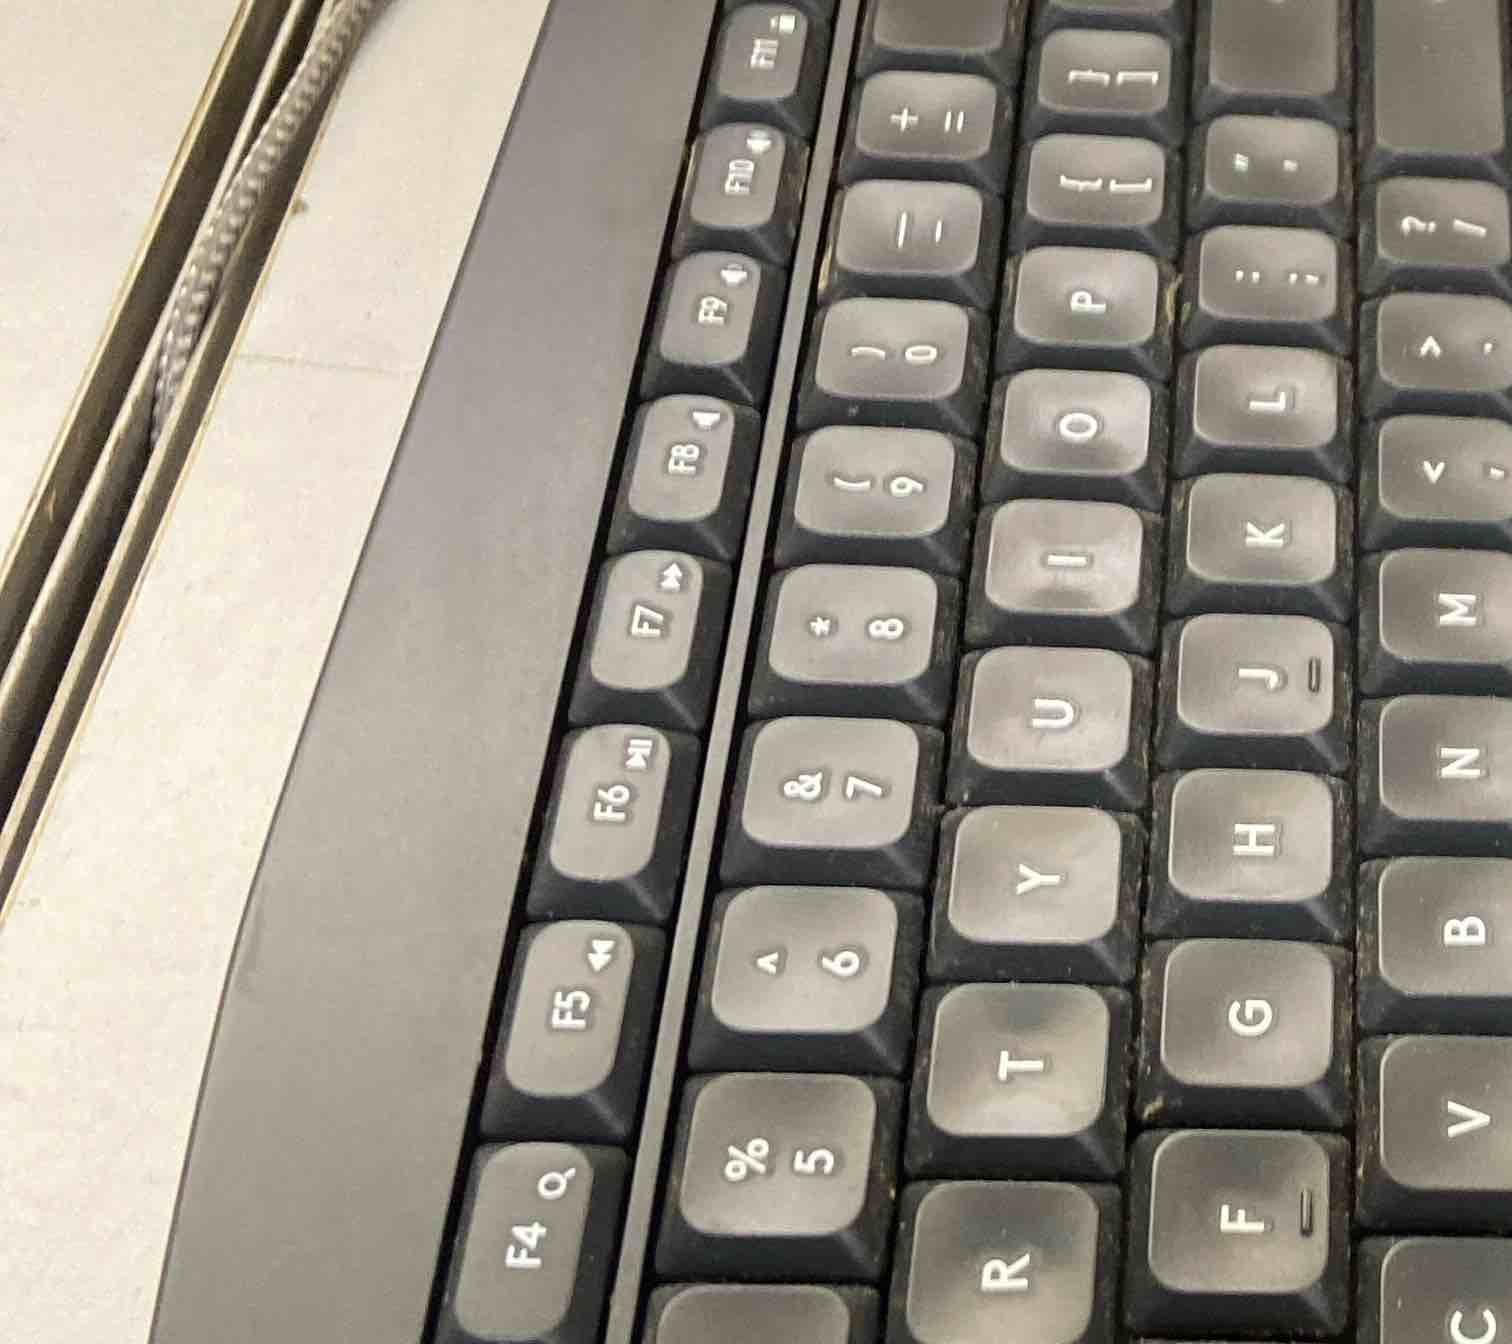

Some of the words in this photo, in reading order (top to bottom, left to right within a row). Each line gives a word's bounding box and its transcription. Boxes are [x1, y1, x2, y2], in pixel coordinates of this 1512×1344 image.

[1401, 215, 1437, 233] ?
[1453, 219, 1487, 237] /
[698, 296, 728, 324] F9
[1070, 291, 1106, 312] P
[851, 346, 886, 358] )
[1249, 391, 1287, 412] L
[1059, 412, 1098, 441] O
[668, 444, 700, 473] F8
[834, 477, 871, 490] (
[890, 476, 923, 497] 9
[1245, 521, 1285, 547] K
[1047, 554, 1087, 565] I
[631, 605, 664, 636] F7
[1438, 593, 1477, 626] M
[869, 618, 904, 639] 8
[1238, 668, 1279, 689] J
[1031, 698, 1074, 729] U
[1440, 747, 1481, 779] N
[783, 772, 823, 799] &
[846, 776, 882, 798] 7
[593, 785, 630, 820] F6
[1233, 823, 1276, 856] H
[1015, 863, 1061, 895] Y
[1443, 916, 1486, 946] B
[757, 952, 779, 974] ^
[822, 950, 860, 976] 6
[551, 990, 590, 1028] F5
[1228, 999, 1273, 1036] G
[998, 1050, 1044, 1081] T
[1447, 1100, 1491, 1138] V
[724, 1138, 769, 1181] %
[794, 1149, 834, 1174] 5
[1220, 1204, 1265, 1233] F
[505, 1221, 547, 1268] F4
[981, 1253, 1030, 1291] R
